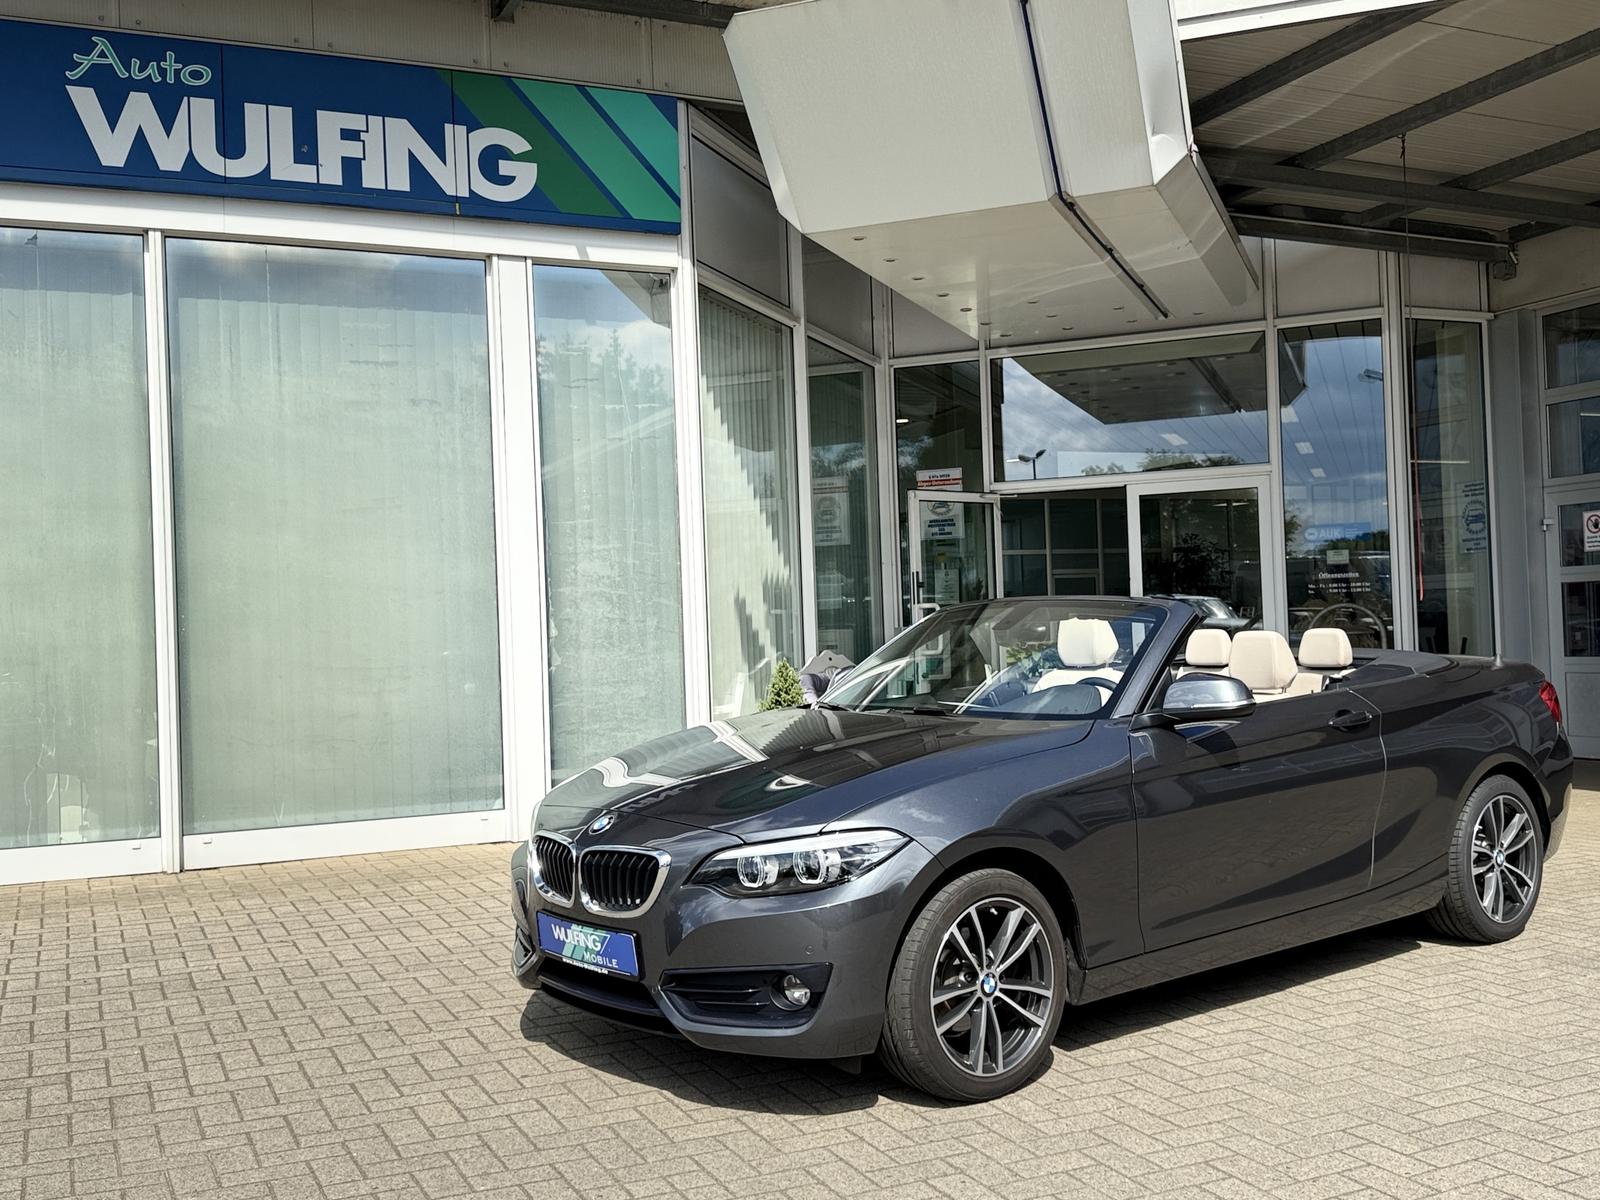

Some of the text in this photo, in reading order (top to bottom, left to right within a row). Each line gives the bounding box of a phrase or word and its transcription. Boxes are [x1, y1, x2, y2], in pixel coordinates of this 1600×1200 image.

[65, 36, 212, 86] Auto
[65, 84, 538, 203] WULFING
[551, 923, 602, 951] WULFING
[582, 950, 619, 969] MOBILE
